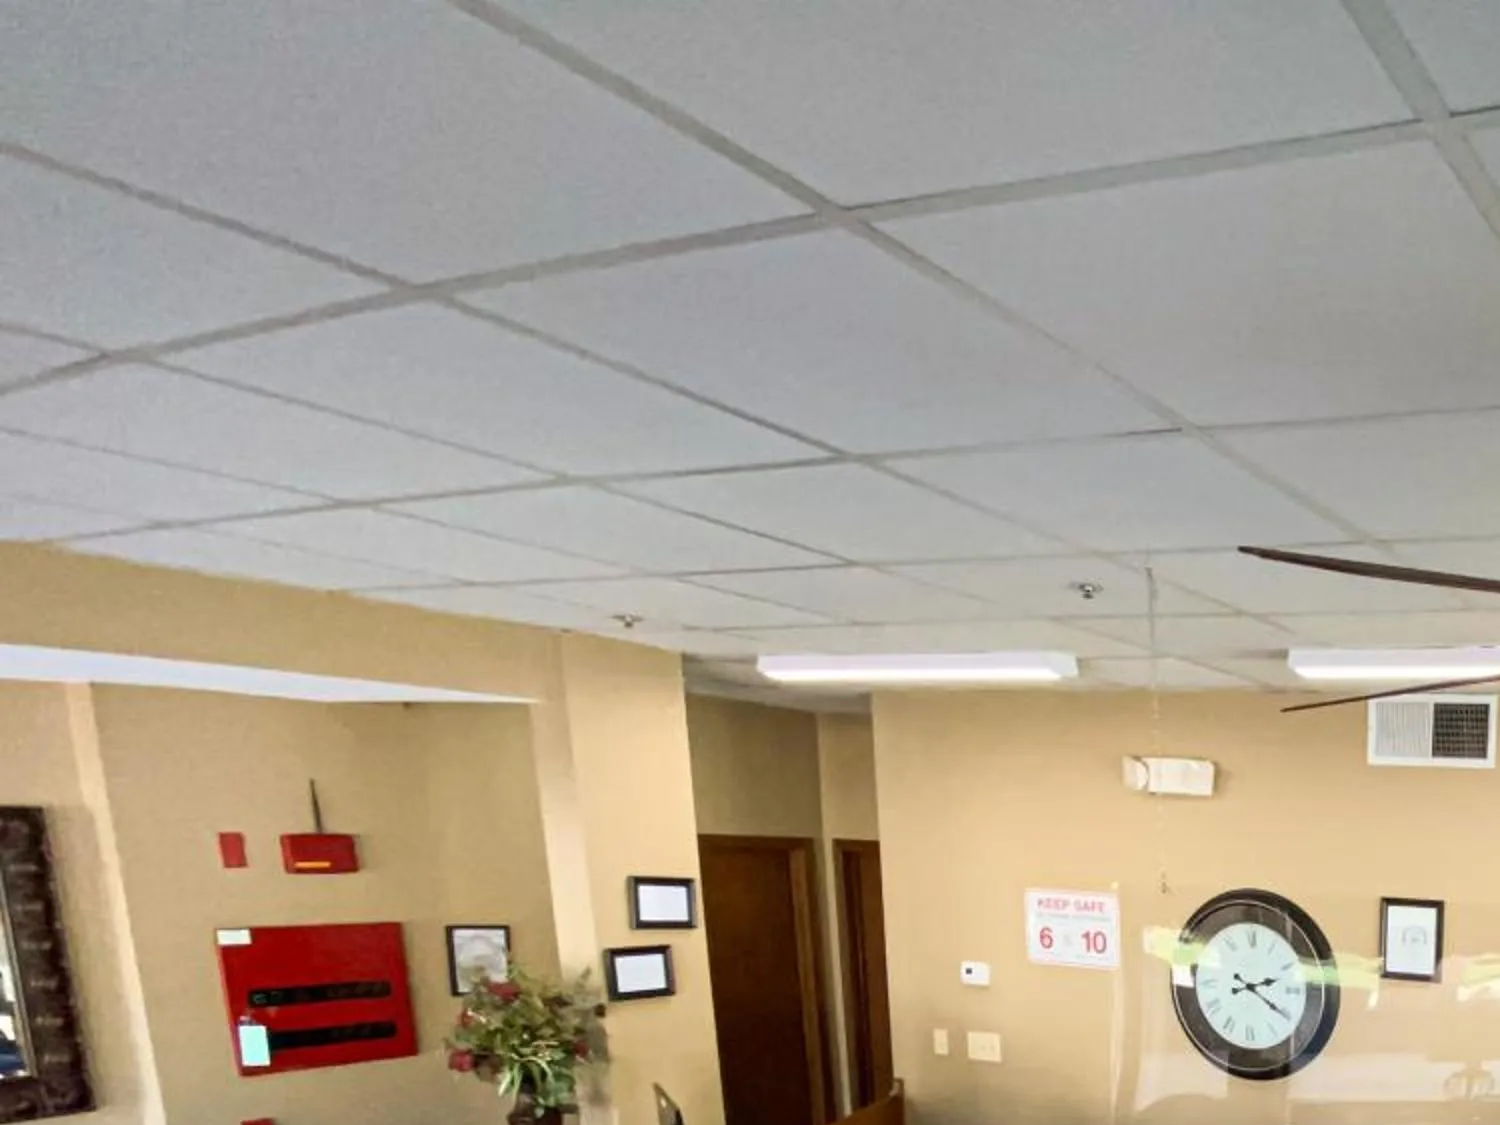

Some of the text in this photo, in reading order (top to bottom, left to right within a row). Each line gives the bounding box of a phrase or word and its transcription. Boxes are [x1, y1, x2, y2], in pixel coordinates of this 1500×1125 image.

[1037, 898, 1070, 910] KEEP
[1039, 926, 1054, 949] 6
[1080, 930, 1107, 954] 10
